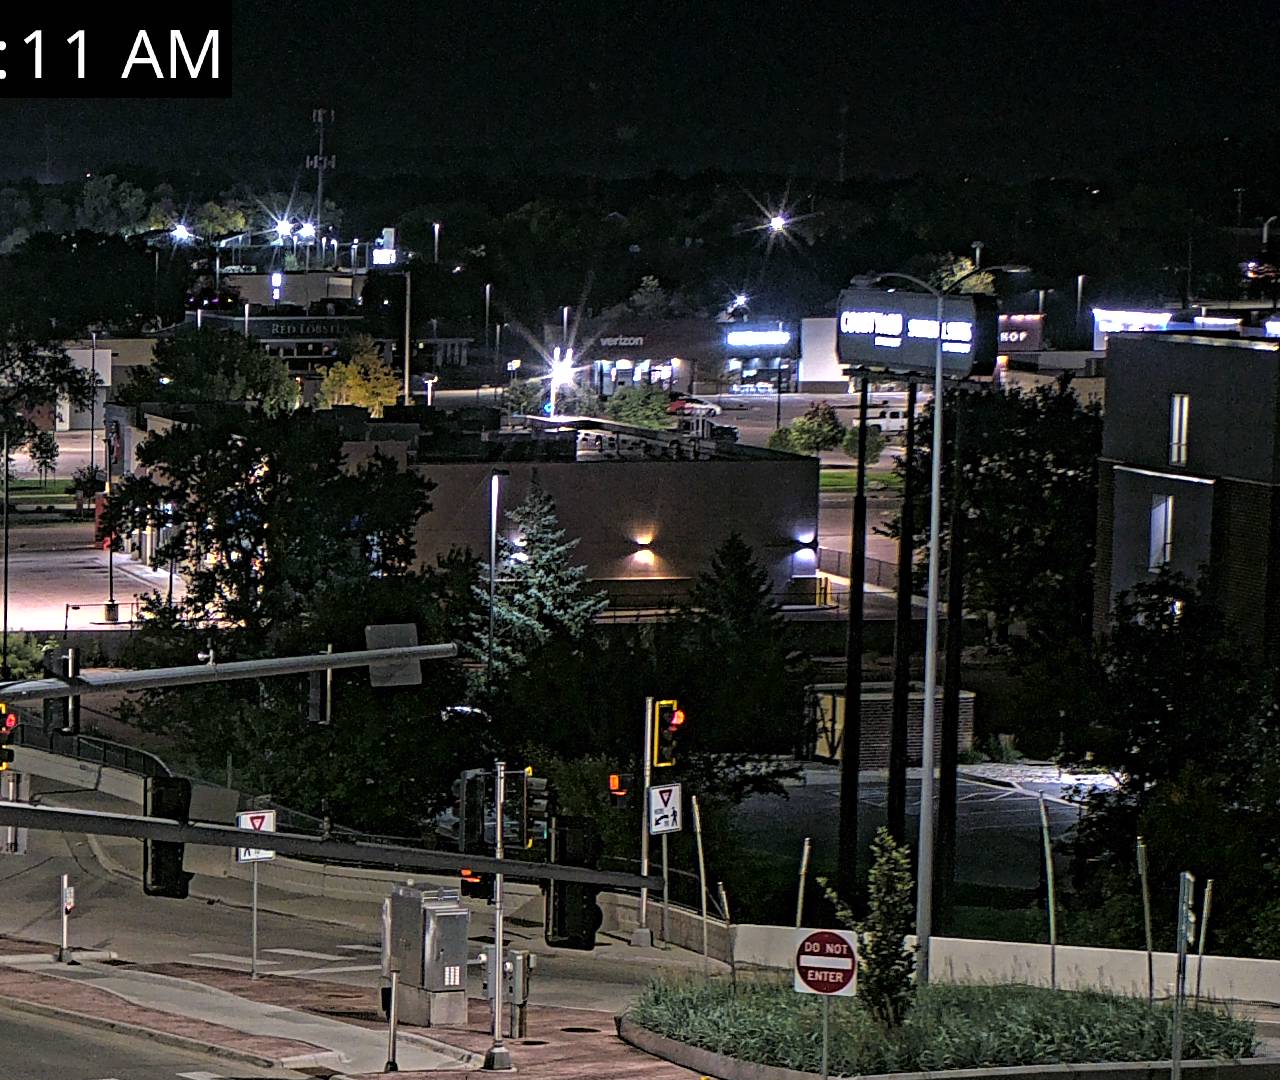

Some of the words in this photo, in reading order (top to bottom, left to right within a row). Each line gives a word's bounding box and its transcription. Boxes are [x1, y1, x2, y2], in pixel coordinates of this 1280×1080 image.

[600, 335, 644, 347] verizon
[804, 941, 820, 953] DO
[825, 943, 848, 955] NOT
[806, 970, 843, 982] ENTER
